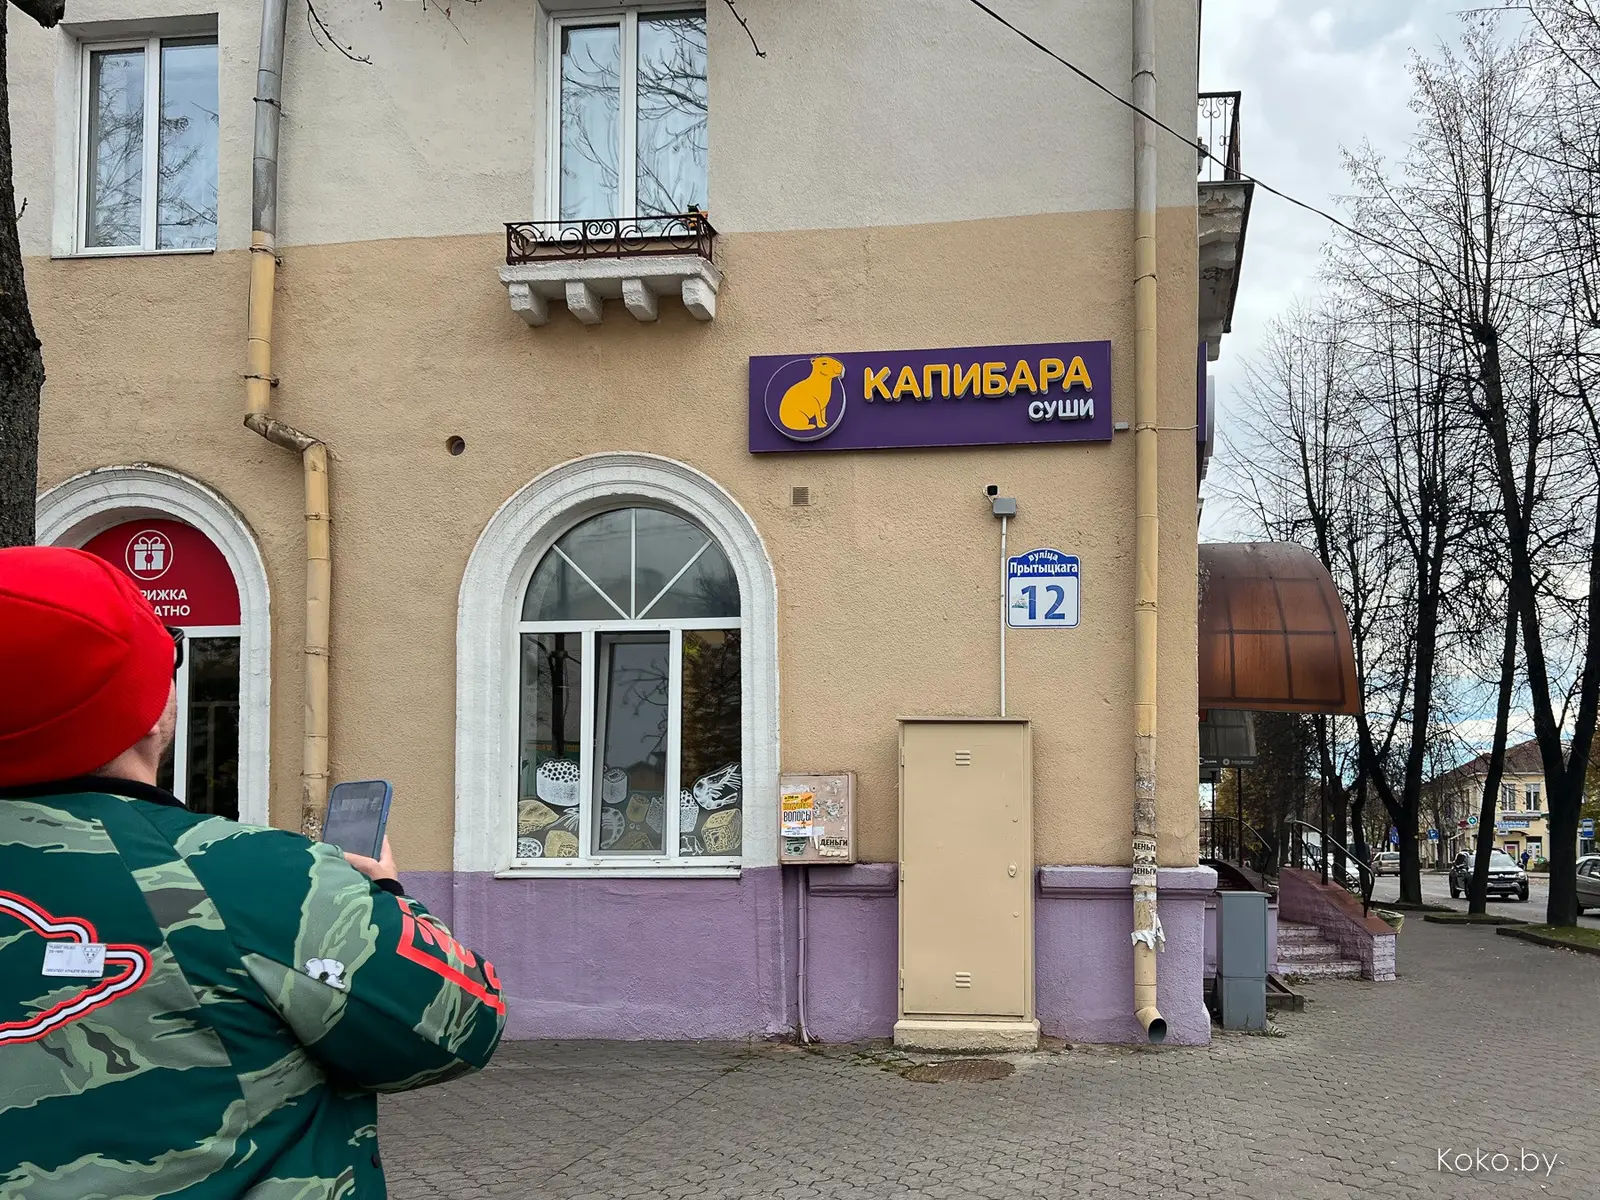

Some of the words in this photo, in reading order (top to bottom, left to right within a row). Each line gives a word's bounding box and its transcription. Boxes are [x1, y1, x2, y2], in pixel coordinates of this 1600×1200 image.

[864, 355, 1093, 402] КАПИБАРА
[1028, 398, 1094, 421] СУШИ
[1028, 550, 1058, 562] вуліца
[1010, 562, 1078, 576] Прытыцкага
[140, 588, 188, 601] РИЖКА
[1021, 585, 1065, 620] 12
[153, 604, 191, 617] АТНО
[783, 811, 812, 823] ВОЛОСЫ
[820, 839, 848, 847] ДЕНЬГИ
